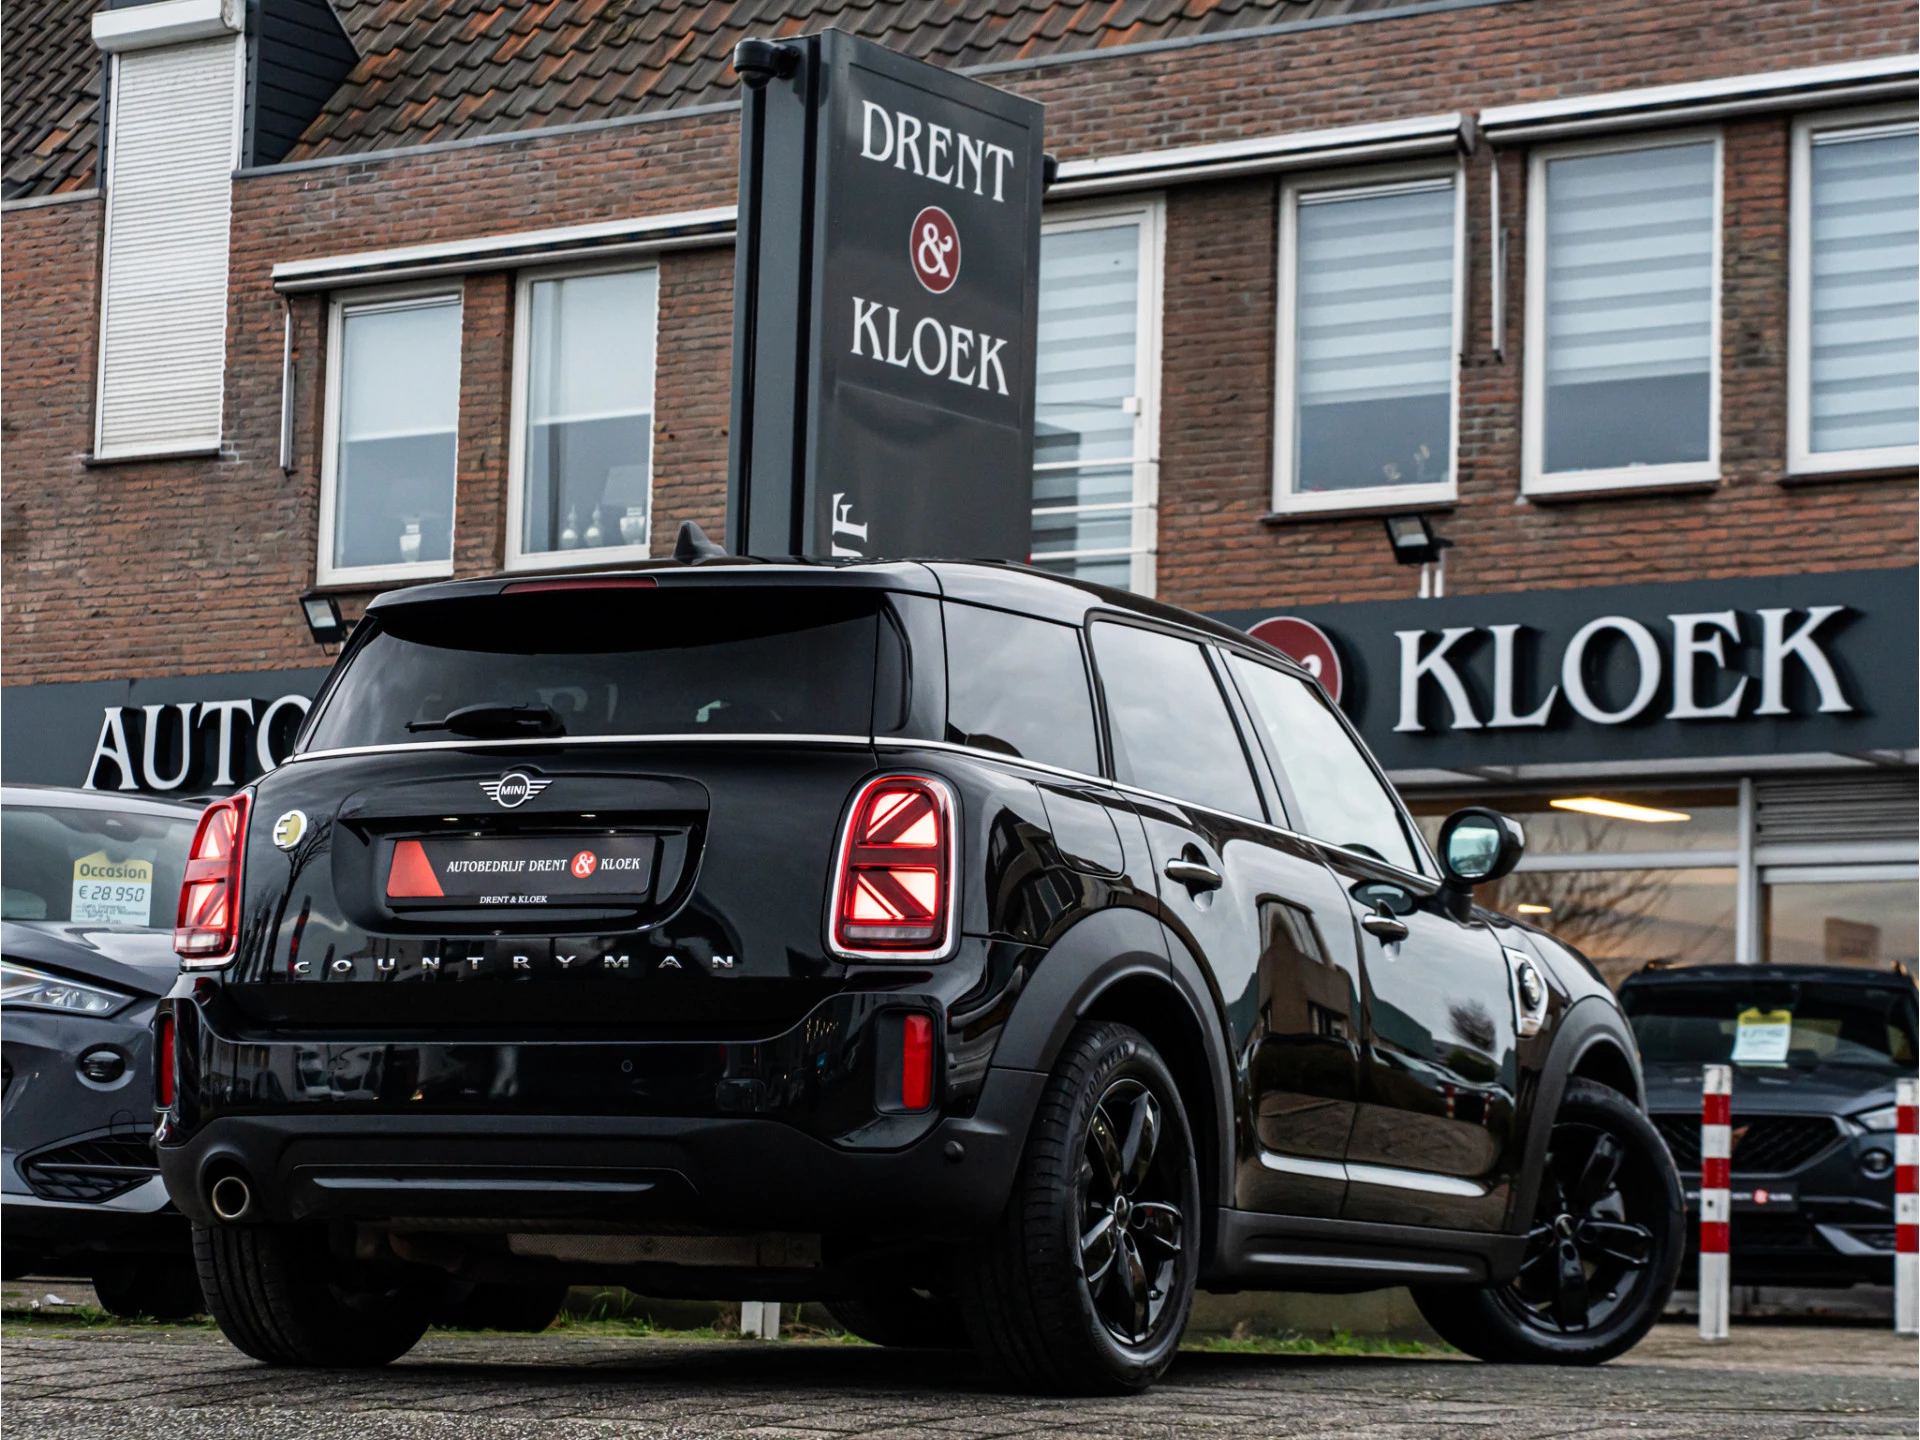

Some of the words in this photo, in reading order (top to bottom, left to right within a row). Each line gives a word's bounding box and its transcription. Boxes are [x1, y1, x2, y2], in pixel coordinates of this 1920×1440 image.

[860, 99, 1014, 203] DRENT
[917, 222, 954, 278] &
[850, 296, 1010, 396] KLOEK
[1393, 605, 1853, 732] KLOEK
[500, 785, 526, 796] MINI
[79, 863, 147, 880] Occasion
[446, 859, 526, 873] AUTOBEDRIJF
[528, 858, 568, 872] DRENT
[574, 853, 595, 875] &
[600, 857, 641, 871] KLOEK
[78, 885, 89, 900] €
[91, 885, 145, 902] 28.950
[479, 895, 509, 904] DRENT
[509, 895, 517, 904] &
[518, 895, 548, 904] KLOEK
[293, 955, 735, 974] COUNTRYMAN
